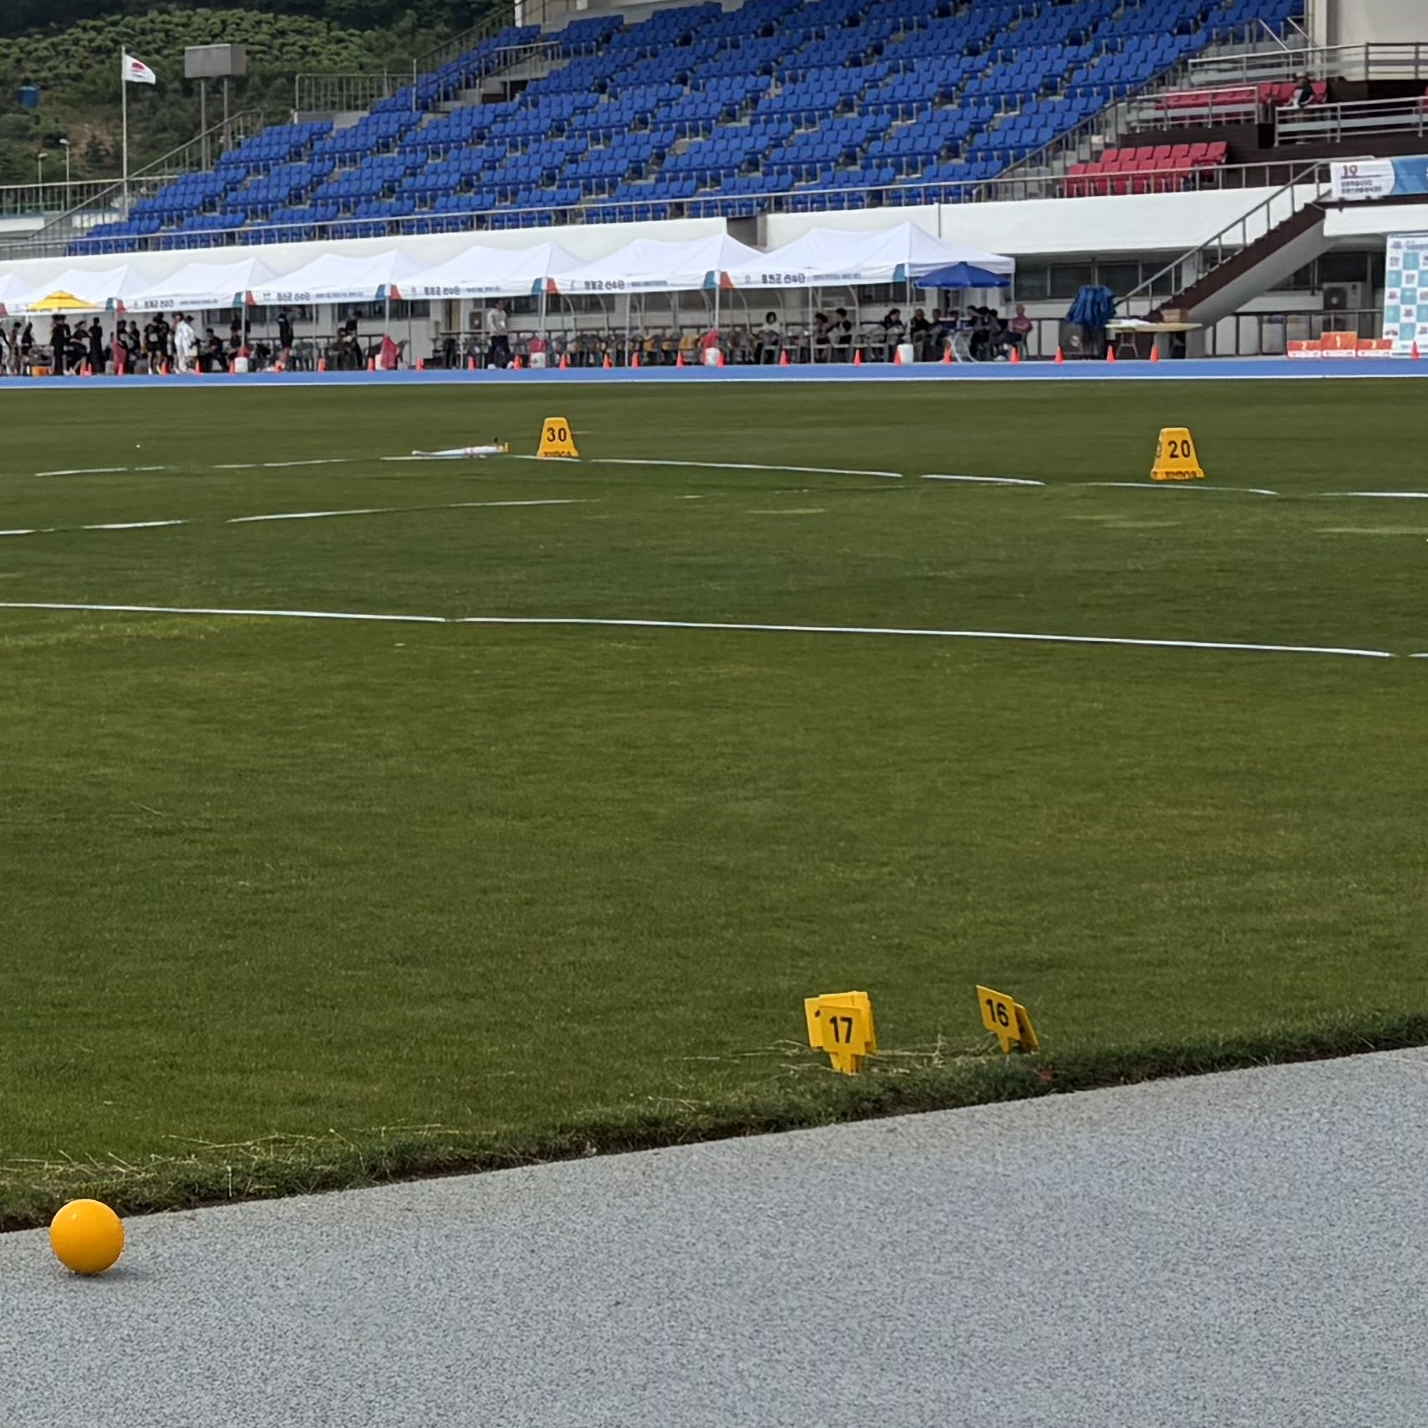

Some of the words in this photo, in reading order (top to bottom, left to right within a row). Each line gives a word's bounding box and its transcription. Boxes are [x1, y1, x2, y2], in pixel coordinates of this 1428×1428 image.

[546, 427, 567, 442] 30
[1168, 439, 1191, 458] 20
[986, 998, 1010, 1028] 16
[830, 1016, 853, 1044] 17
